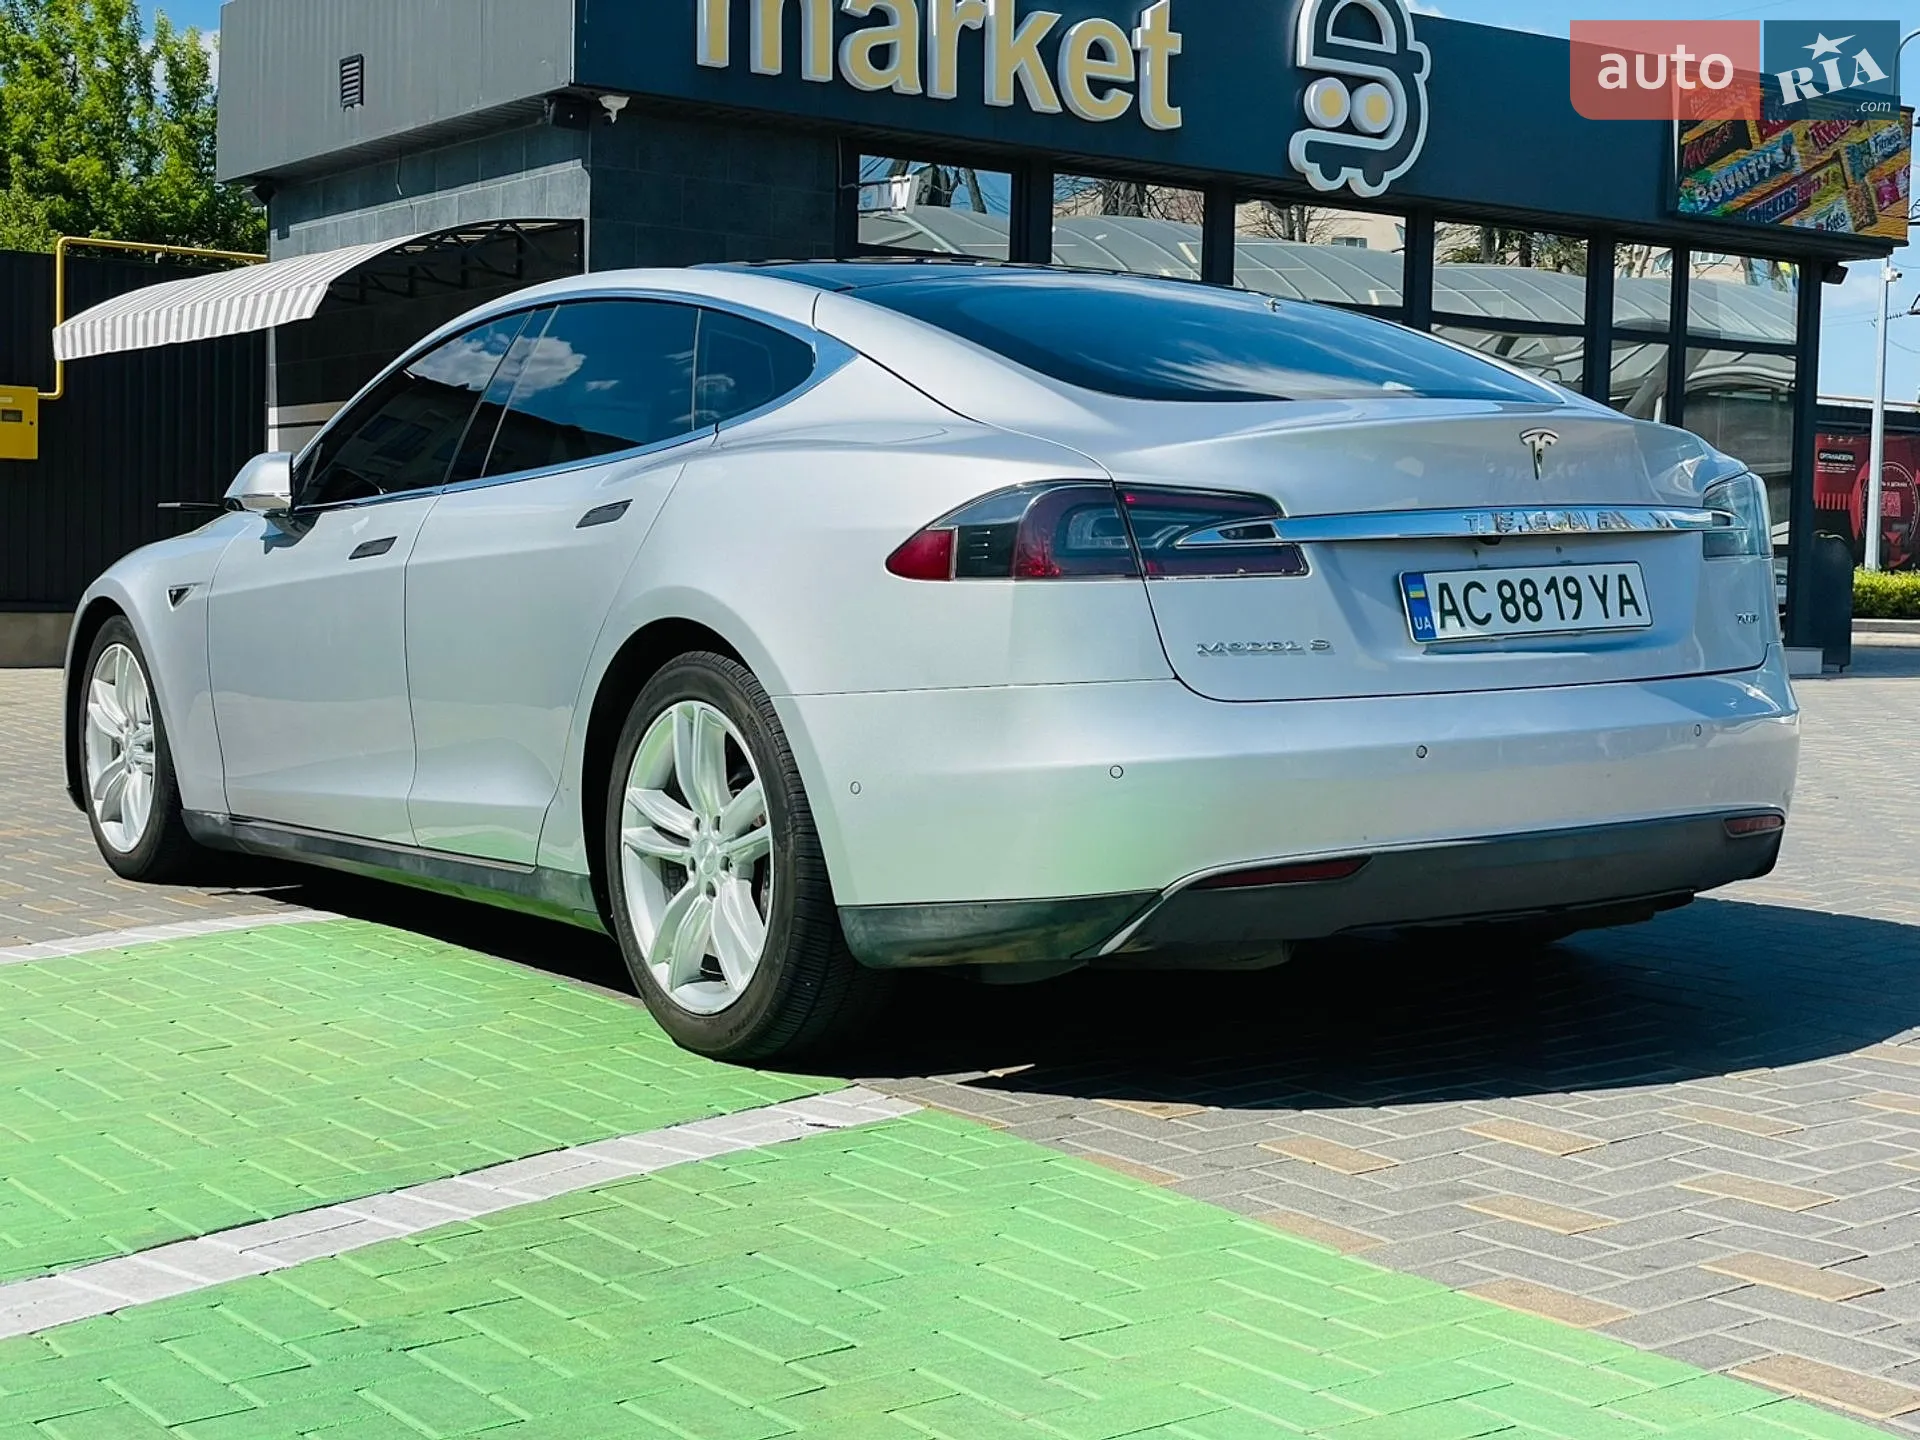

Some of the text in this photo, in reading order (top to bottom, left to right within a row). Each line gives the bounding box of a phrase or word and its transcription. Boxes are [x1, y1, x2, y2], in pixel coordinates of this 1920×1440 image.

[697, 0, 1182, 130] market
[1695, 152, 1771, 211] BOUNTY
[1414, 616, 1433, 631] UA
[1438, 573, 1642, 629] AC 8819 YA
